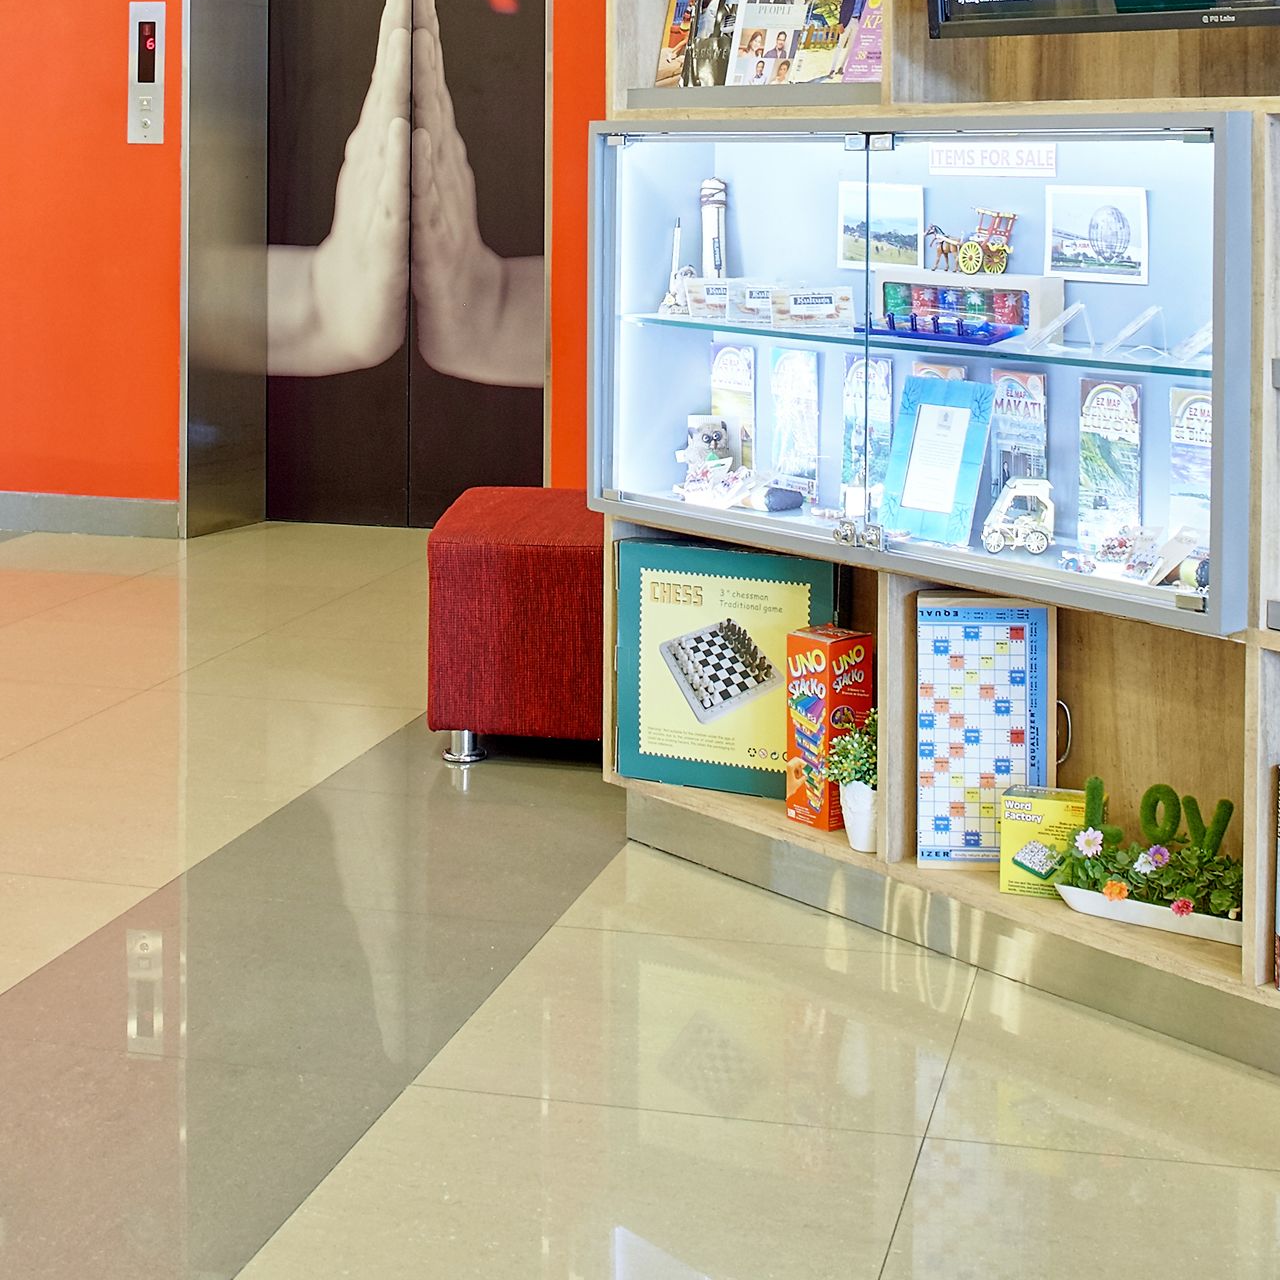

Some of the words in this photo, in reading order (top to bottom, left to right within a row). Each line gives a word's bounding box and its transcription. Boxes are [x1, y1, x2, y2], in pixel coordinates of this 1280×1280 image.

[931, 147, 975, 166] ITEMS
[980, 148, 1010, 167] FOR
[1016, 148, 1054, 168] SALE
[650, 581, 703, 606] CHESS
[720, 600, 762, 611] Traditional
[763, 606, 783, 614] game
[788, 648, 826, 673] UNO
[832, 644, 864, 674] UNO
[788, 678, 826, 699] STACKO
[832, 669, 864, 694] STACKO
[1005, 800, 1032, 811] Word
[1004, 812, 1043, 824] Factory
